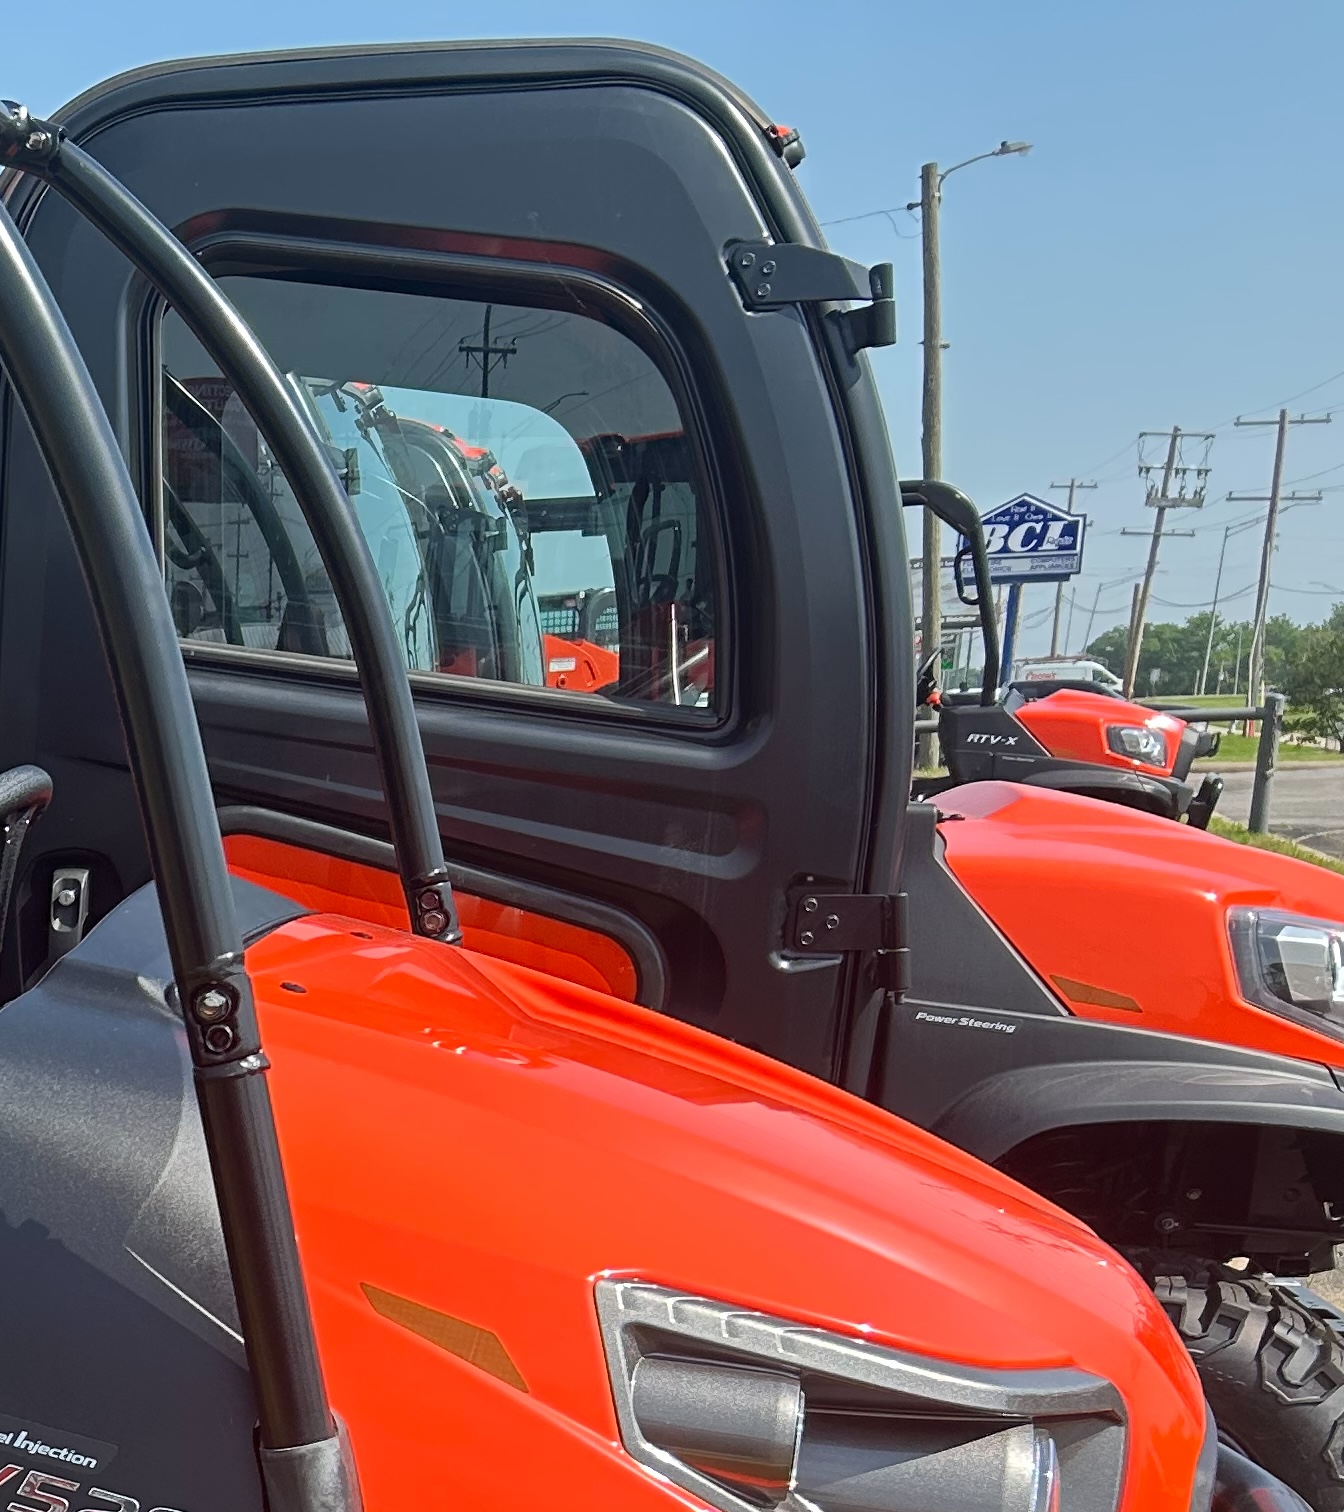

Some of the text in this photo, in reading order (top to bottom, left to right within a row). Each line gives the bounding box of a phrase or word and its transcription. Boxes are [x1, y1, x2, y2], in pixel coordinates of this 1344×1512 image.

[966, 733, 1019, 746] RTV-X
[915, 1011, 1016, 1034] Power Steering
[12, 1430, 99, 1470] Injection
